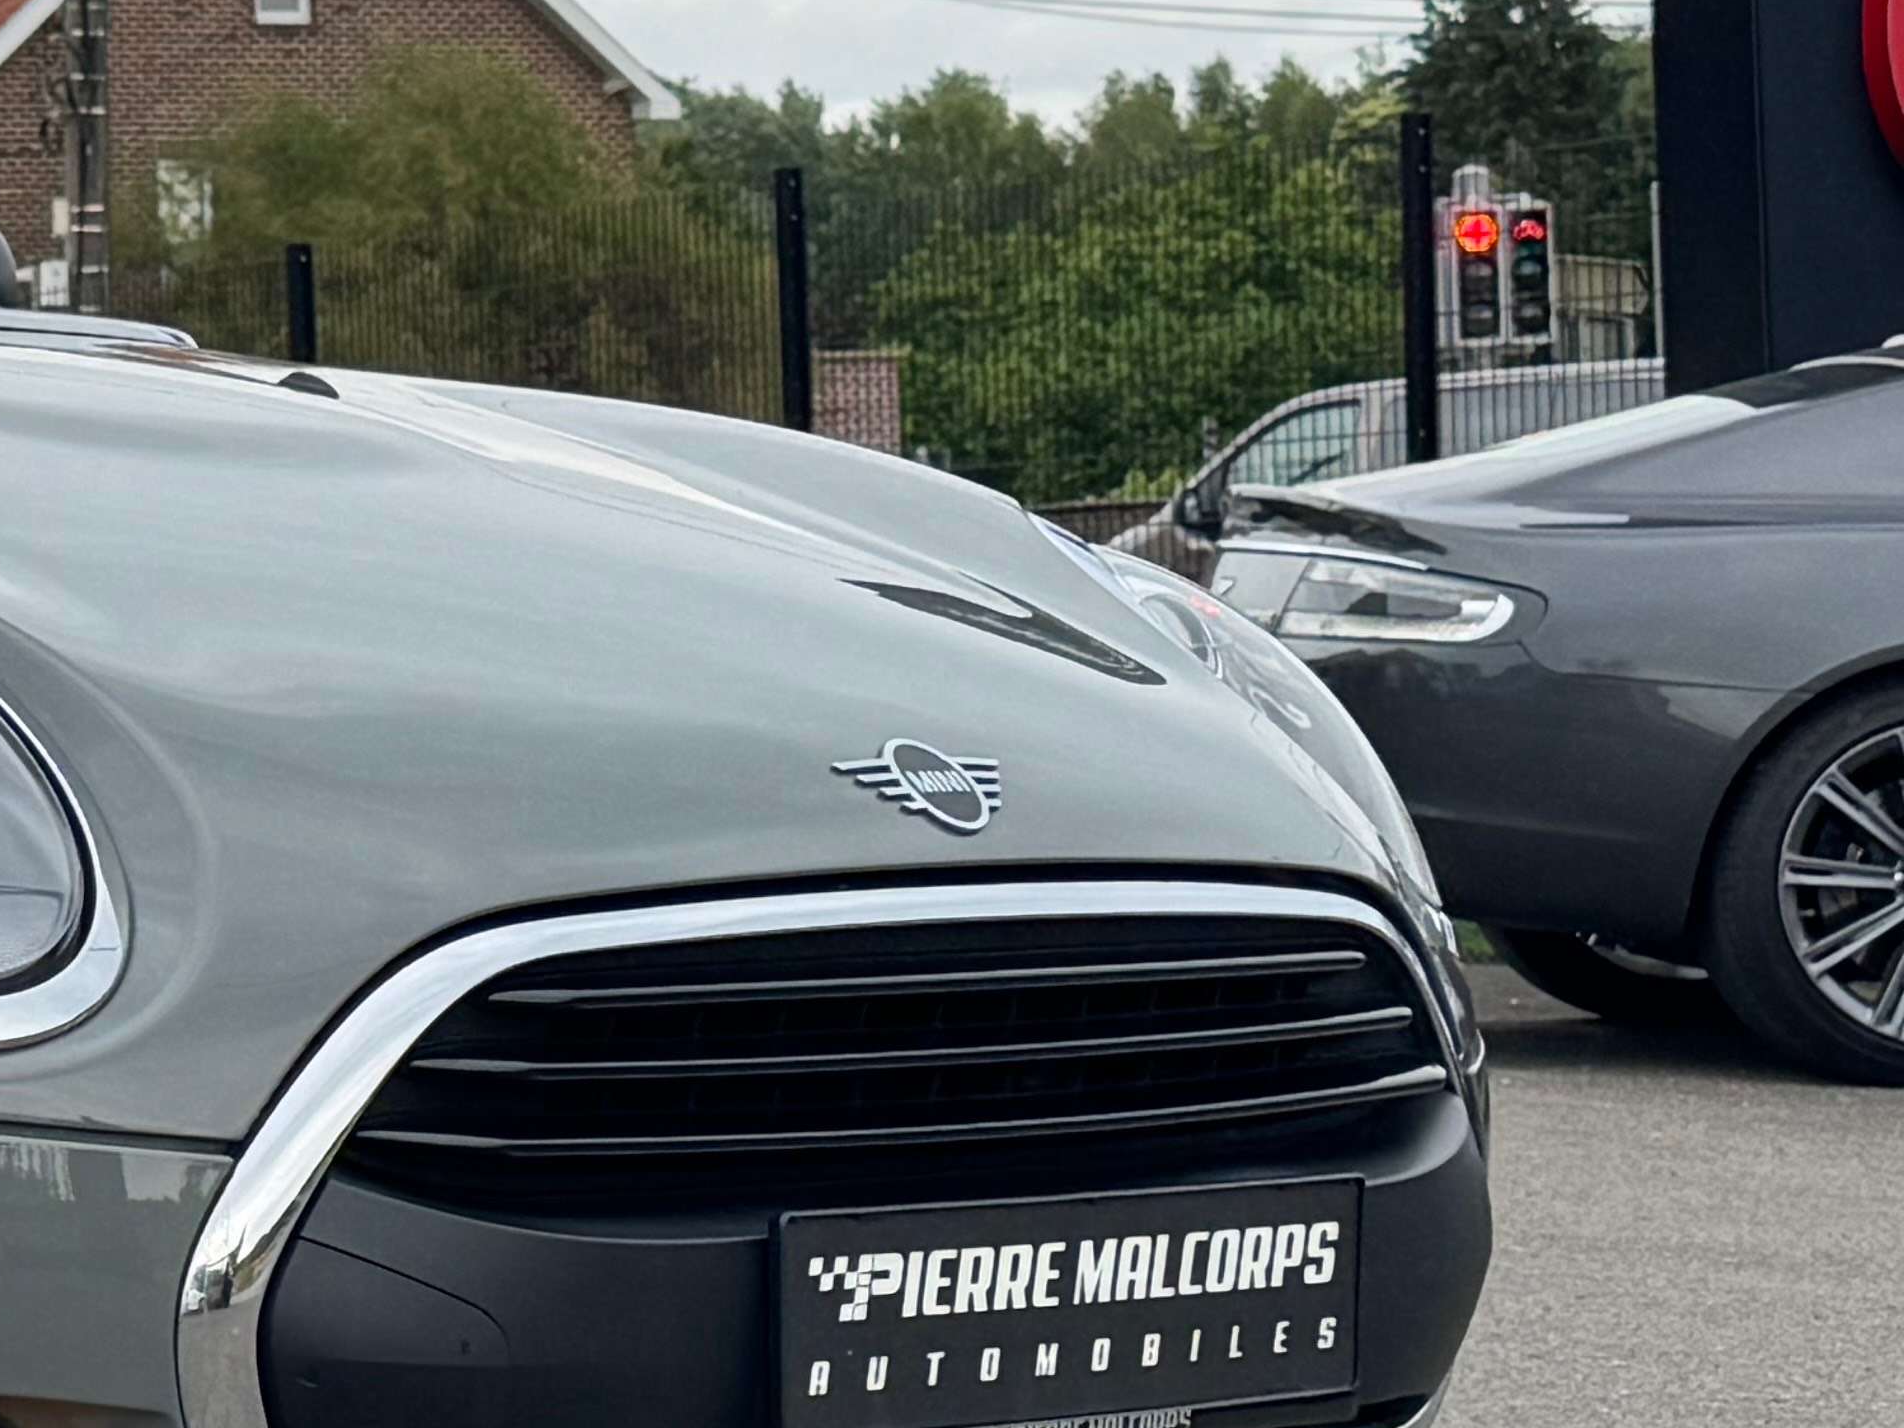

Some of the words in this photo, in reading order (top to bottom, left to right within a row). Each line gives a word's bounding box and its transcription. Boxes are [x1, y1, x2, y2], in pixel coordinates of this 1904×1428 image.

[839, 1241, 1067, 1322] PIERRE
[1073, 1221, 1339, 1305] MALCORPS
[808, 1317, 1337, 1397] AUTOMOBILES
